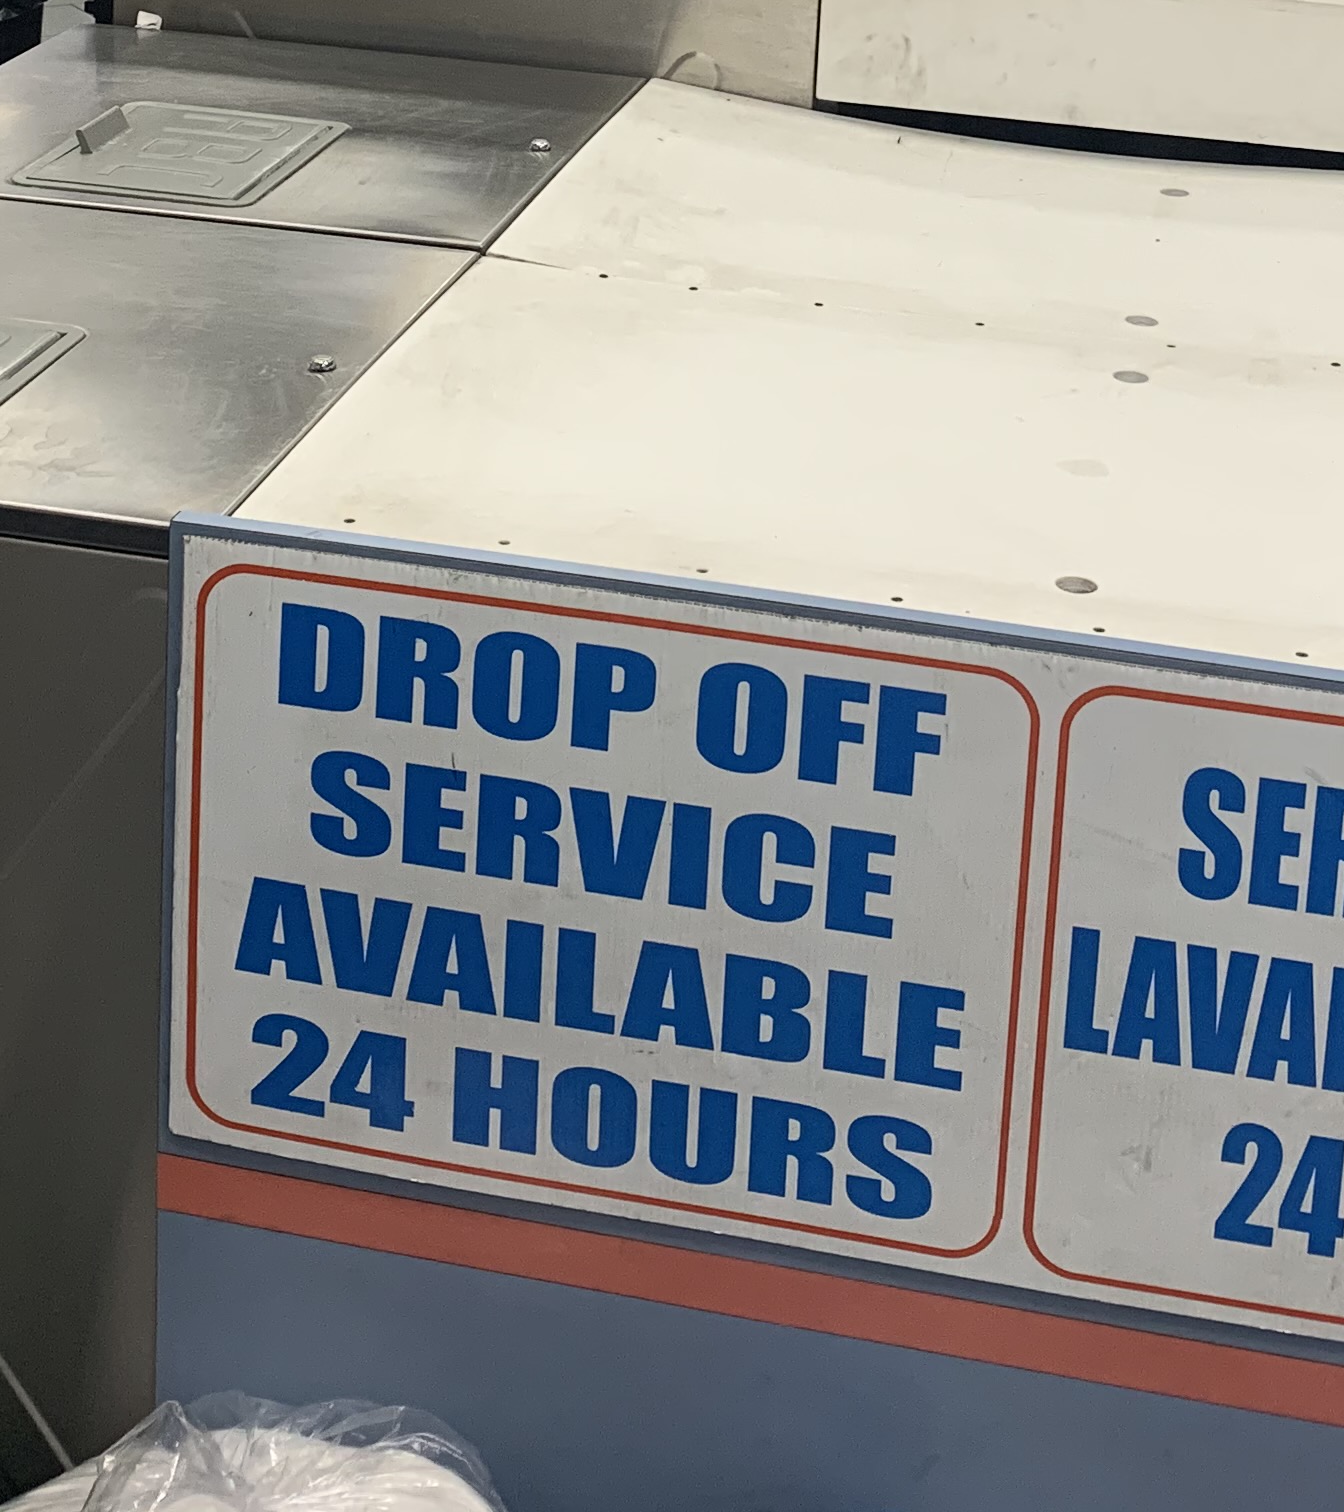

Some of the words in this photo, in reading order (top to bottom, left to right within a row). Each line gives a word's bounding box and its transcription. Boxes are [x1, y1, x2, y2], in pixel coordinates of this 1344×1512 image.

[278, 602, 656, 750] DROP
[695, 662, 947, 797] OFF
[309, 750, 897, 939] SERVICE
[234, 876, 965, 1092] AVAILABLE
[250, 1013, 415, 1132] 24
[453, 1046, 932, 1219] HOURS
